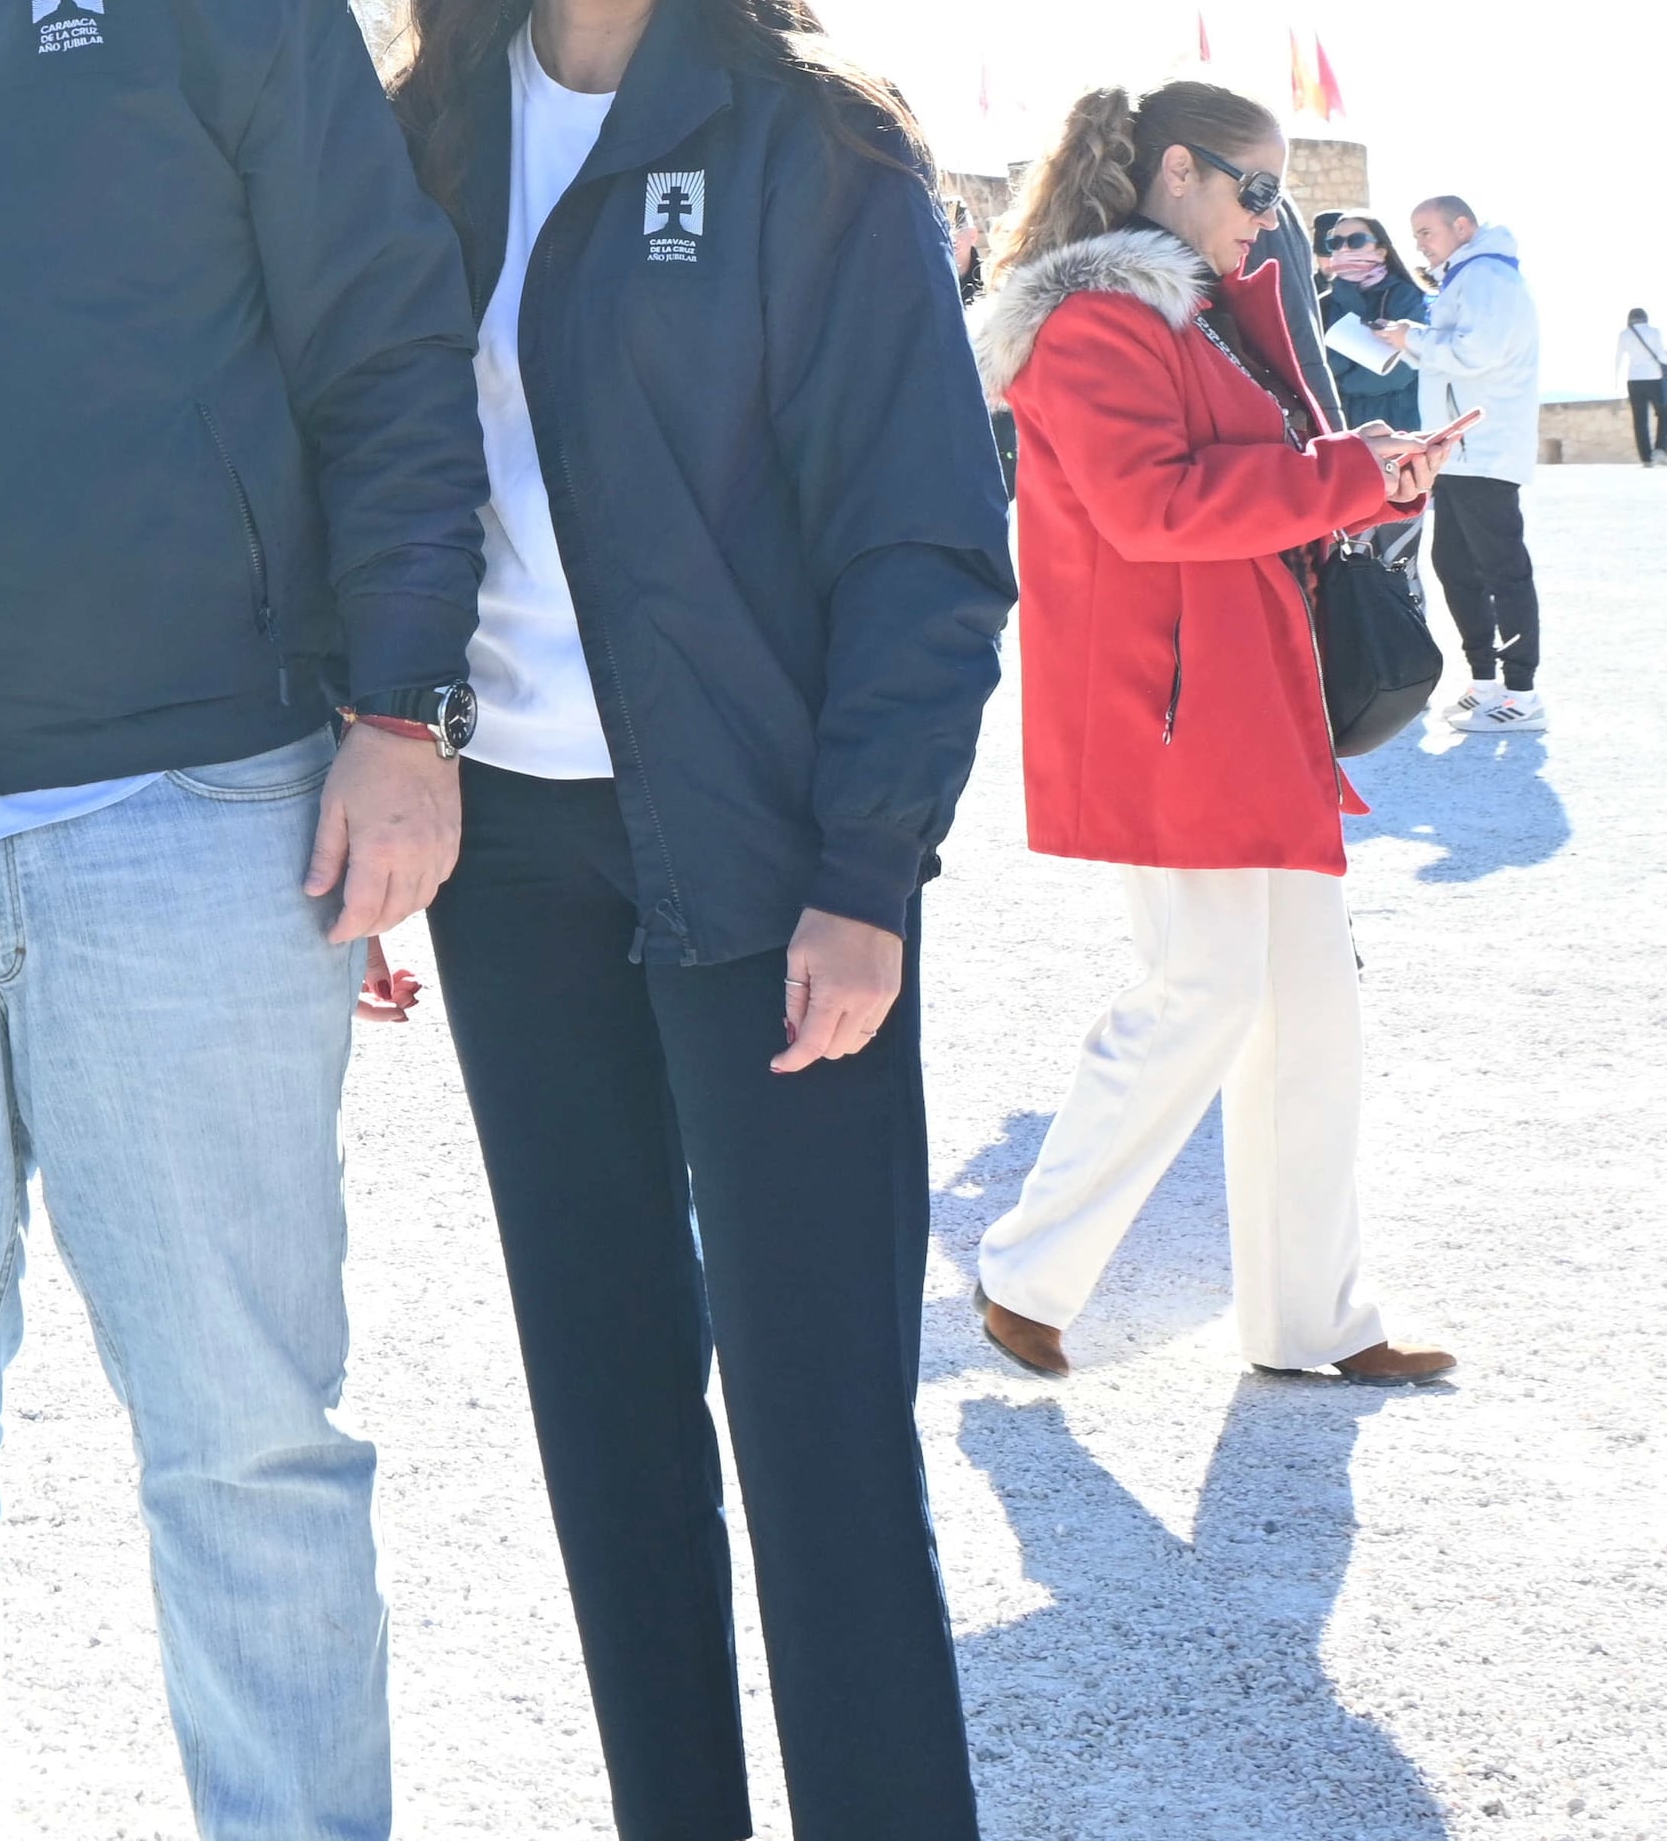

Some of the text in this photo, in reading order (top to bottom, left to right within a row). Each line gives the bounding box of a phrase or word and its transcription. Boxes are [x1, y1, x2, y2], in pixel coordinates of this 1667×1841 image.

[40, 18, 97, 34] CARAVACA
[40, 27, 99, 44] DE LA CRUZ
[38, 35, 104, 54] AÑO JUBILAR
[649, 238, 696, 247] CARAVACA
[672, 245, 695, 254] CRUZ
[647, 252, 697, 263] AÑO JUBILAR
